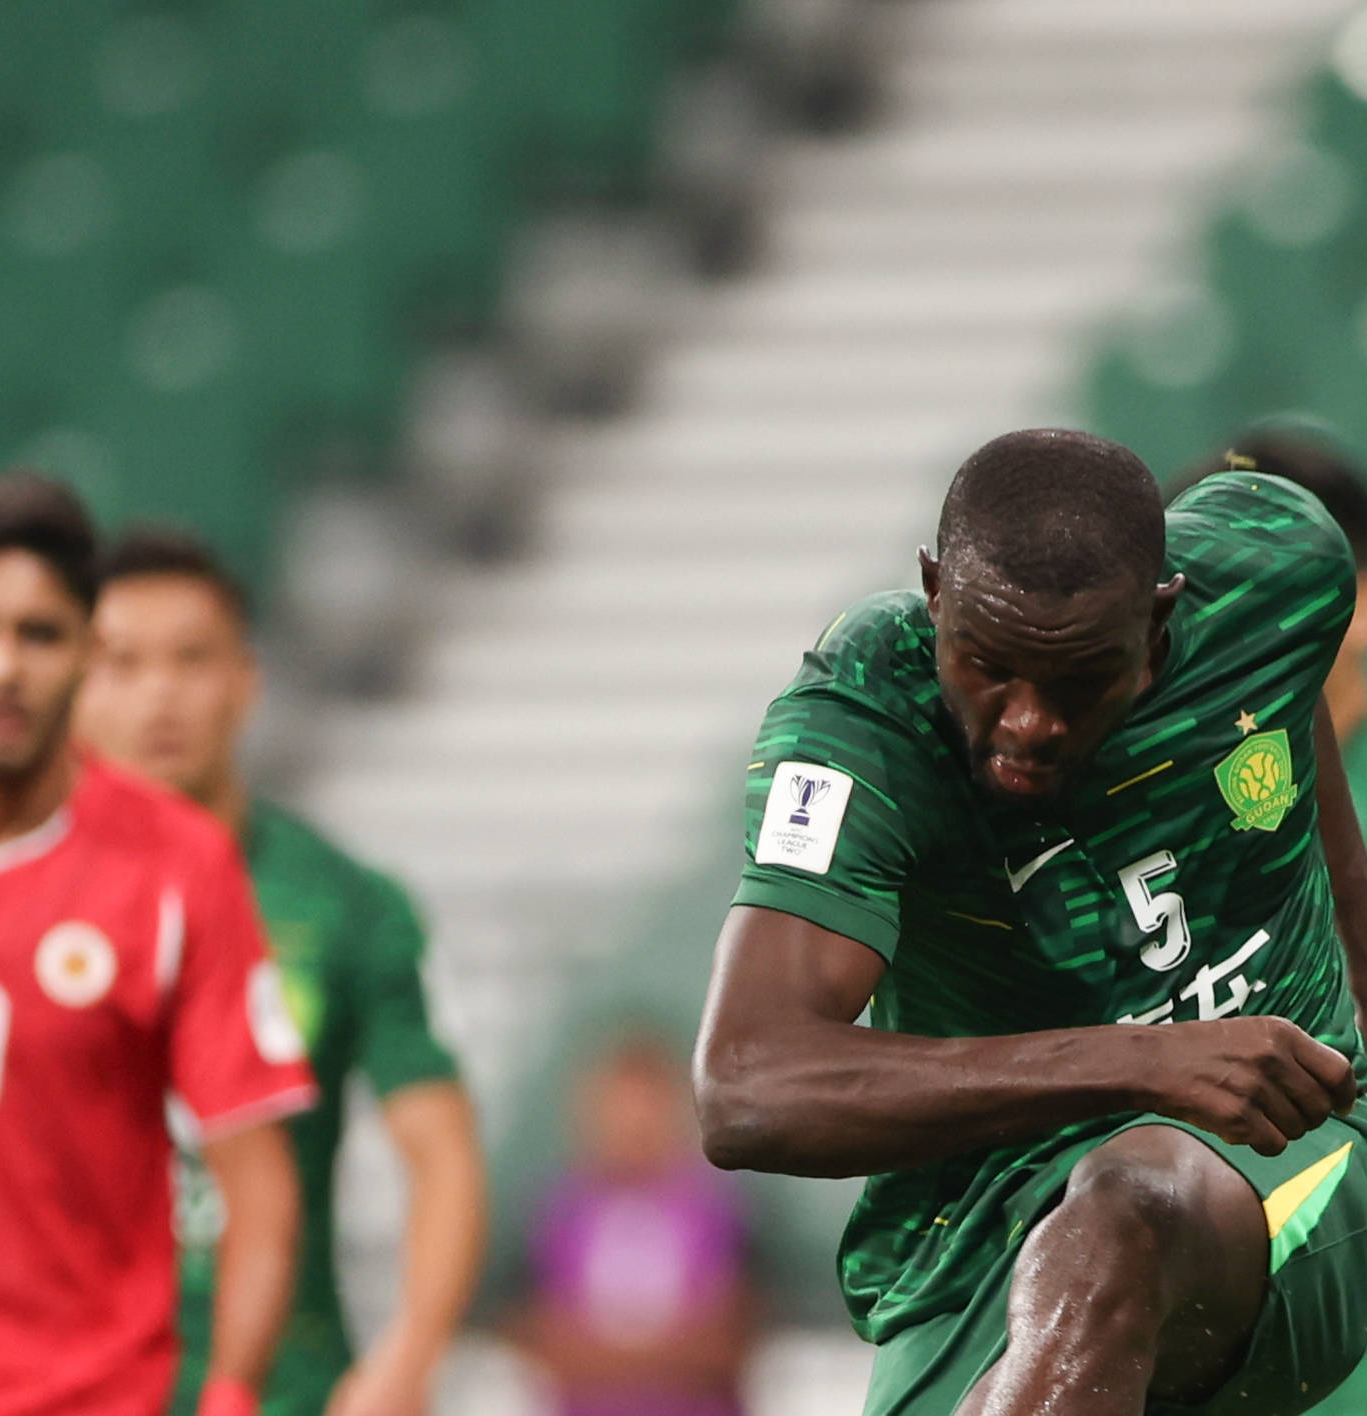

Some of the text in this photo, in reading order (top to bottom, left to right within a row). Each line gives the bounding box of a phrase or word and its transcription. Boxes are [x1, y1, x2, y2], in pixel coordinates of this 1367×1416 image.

[1245, 792, 1290, 824] GUOAN
[781, 845, 802, 856] TWO
[1116, 849, 1192, 972] 5
